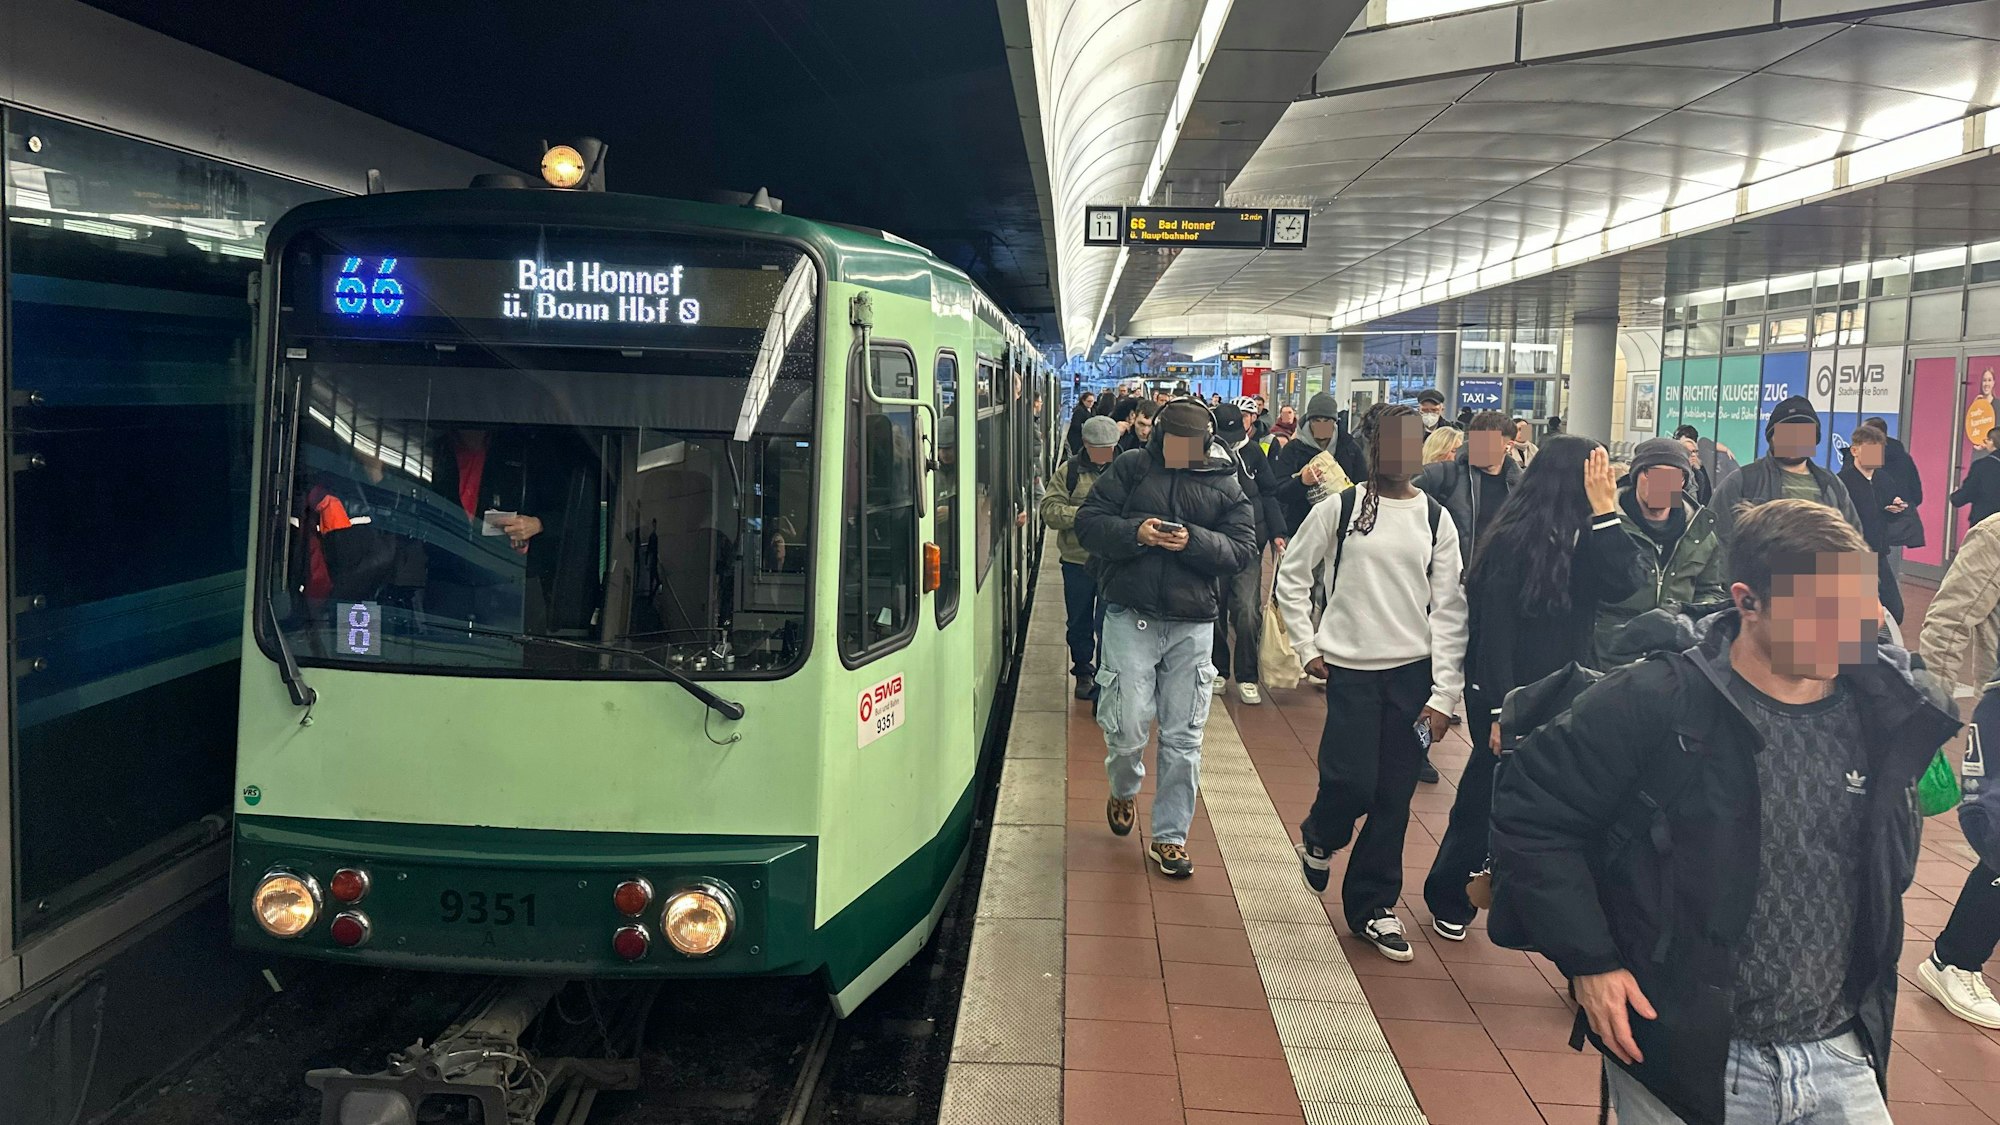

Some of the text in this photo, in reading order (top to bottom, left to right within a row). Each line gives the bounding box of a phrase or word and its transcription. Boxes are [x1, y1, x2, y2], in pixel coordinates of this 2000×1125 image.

[1097, 222, 1111, 236] 11
[1131, 218, 1215, 230] 66 Bad Honnef
[1142, 231, 1199, 240] Hauptbahnhof
[336, 256, 404, 315] 66
[518, 259, 684, 296] Bad Honnef
[503, 292, 528, 318] ü.
[537, 293, 609, 321] Bonn
[619, 296, 669, 323] Hbf
[1839, 364, 1885, 383] SWB
[1462, 393, 1484, 403] TAXI
[1665, 383, 1788, 401] EIN RICHTIG KLUGER ZUG
[1872, 387, 1888, 395] Bonn
[875, 677, 902, 704] SWB
[877, 711, 895, 734] 9351
[243, 788, 257, 796] VRS
[440, 889, 536, 927] 9351
